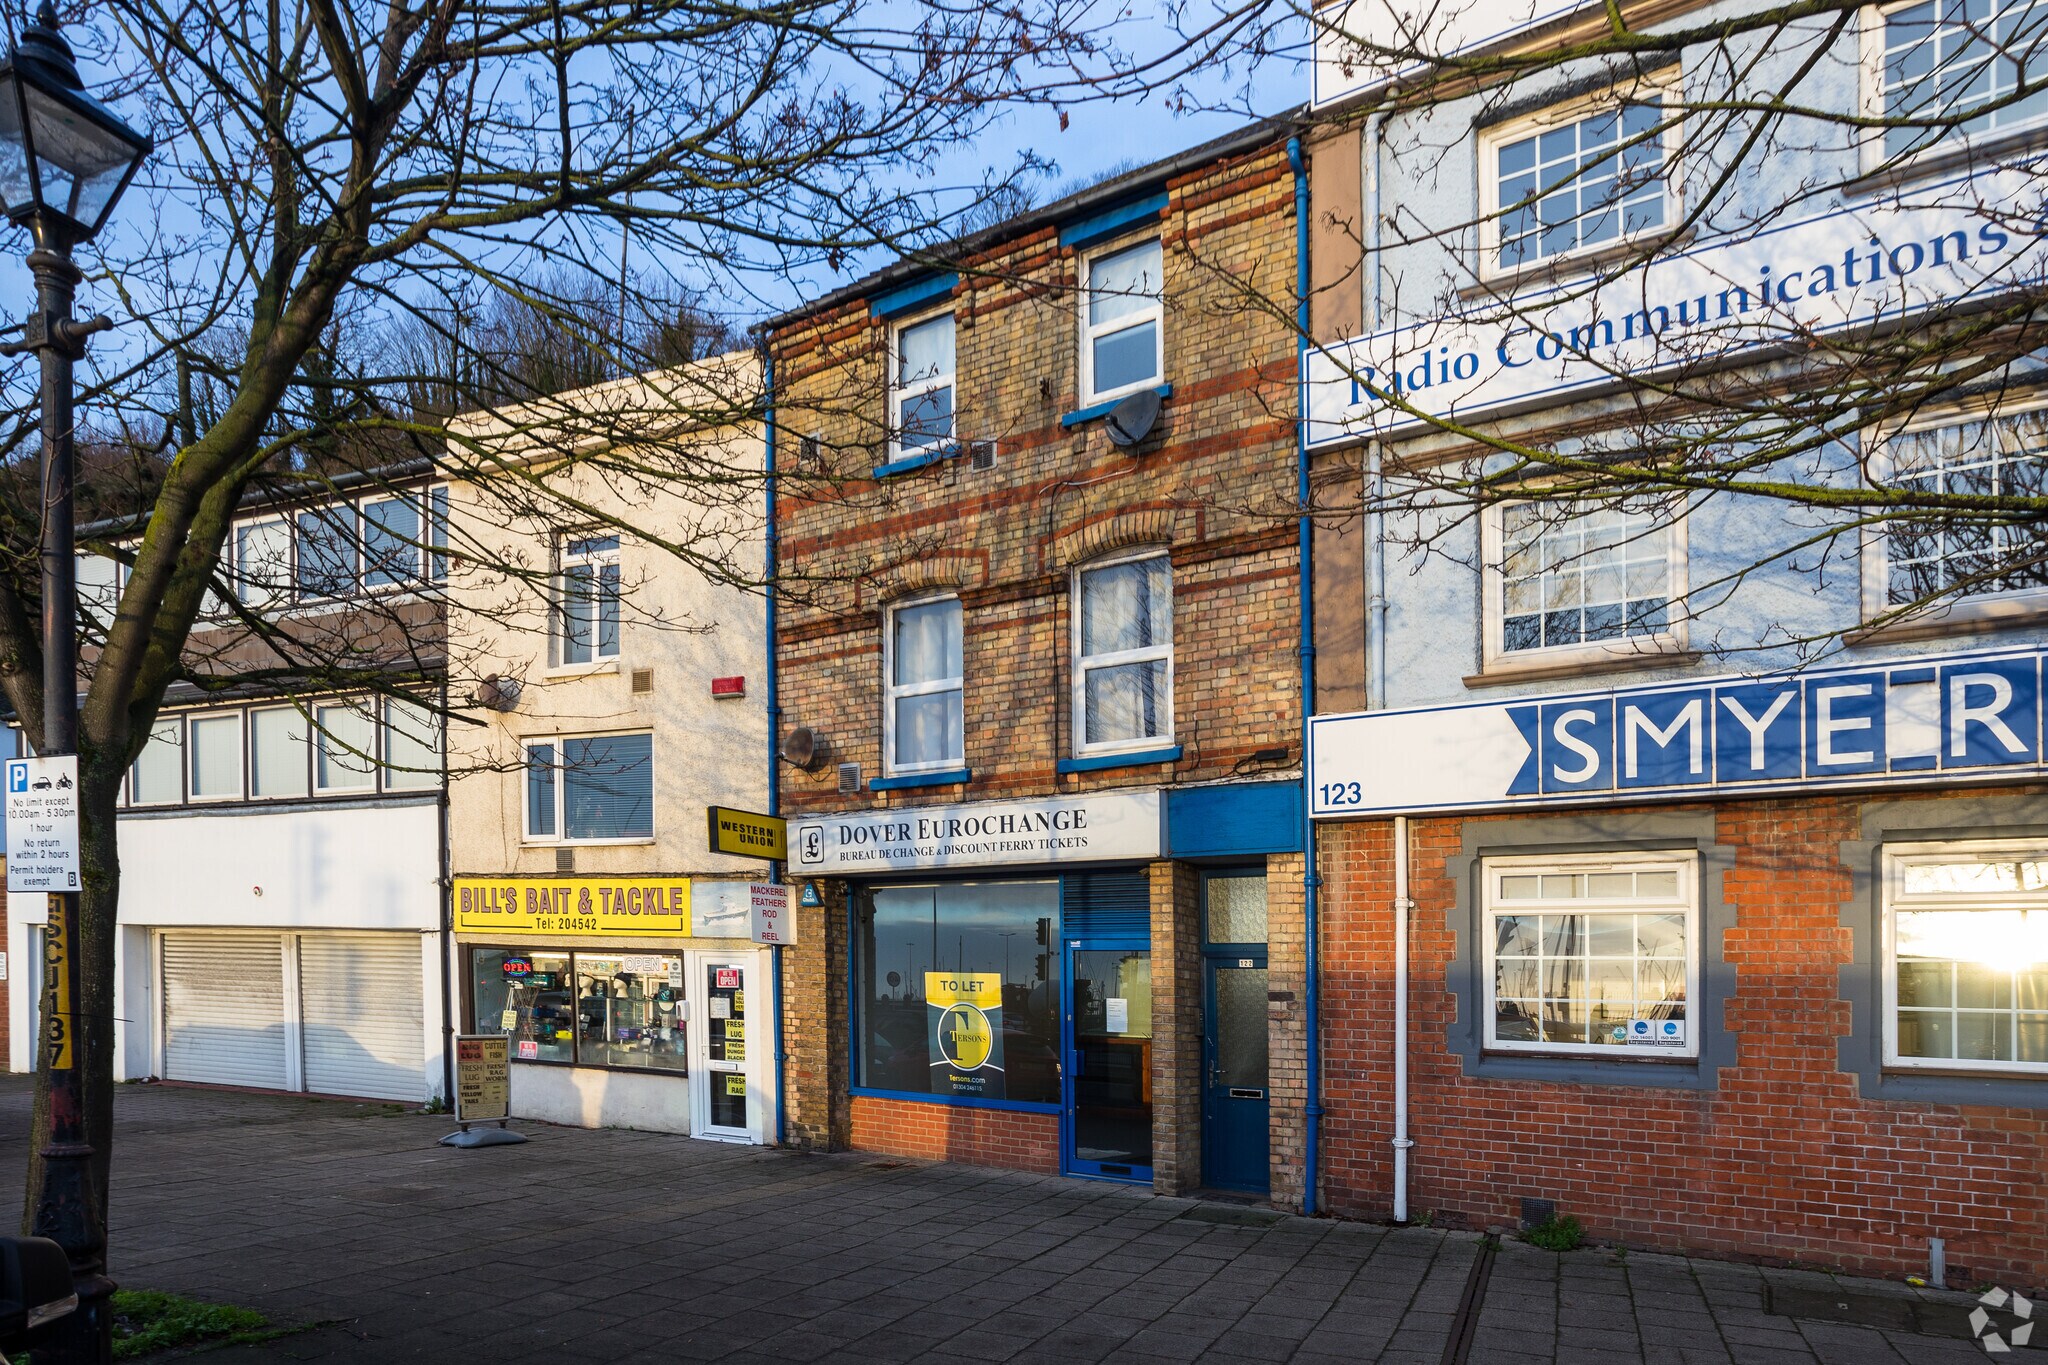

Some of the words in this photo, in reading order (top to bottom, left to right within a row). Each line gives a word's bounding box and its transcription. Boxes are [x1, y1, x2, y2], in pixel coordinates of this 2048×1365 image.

[1348, 346, 1479, 406] Radio
[1497, 219, 2008, 367] Communications
[13, 766, 25, 791] P
[1319, 782, 1362, 806] 123
[13, 799, 24, 808] No
[26, 798, 42, 807] limit
[45, 797, 69, 806] except
[36, 823, 53, 832] hour
[720, 821, 774, 837] WESTERN
[839, 822, 912, 846] DOVER
[918, 809, 1088, 840] EUROCHANGE
[24, 839, 34, 847] No
[37, 839, 60, 847] return
[740, 833, 774, 847] UNION
[16, 851, 38, 859] within
[40, 850, 46, 858] 2
[48, 850, 69, 859] hours
[839, 848, 877, 862] BUREAU
[879, 847, 892, 859] DE
[893, 846, 935, 858] CHANGE
[944, 842, 998, 855] DISCOUNT
[1000, 839, 1036, 852] FERRY
[1038, 836, 1088, 849] TICKETS
[10, 866, 34, 874] Permit
[36, 865, 64, 874] holders
[24, 877, 50, 886] exempt
[750, 885, 787, 897] MACKEREL
[460, 887, 518, 914] BILL'S
[525, 887, 571, 914] BAIT
[578, 887, 594, 915] &
[599, 887, 683, 915] TACKLE
[751, 897, 787, 908] FEATHERS
[762, 909, 777, 918] ROD
[536, 917, 554, 929] Tel:
[558, 918, 597, 930] 204542
[767, 921, 773, 929] &
[761, 932, 779, 940] REEL
[503, 963, 531, 972] OPEN
[624, 957, 660, 972] OPEN
[720, 976, 736, 986] OPEN
[940, 981, 959, 992] TO
[962, 981, 984, 992] LET
